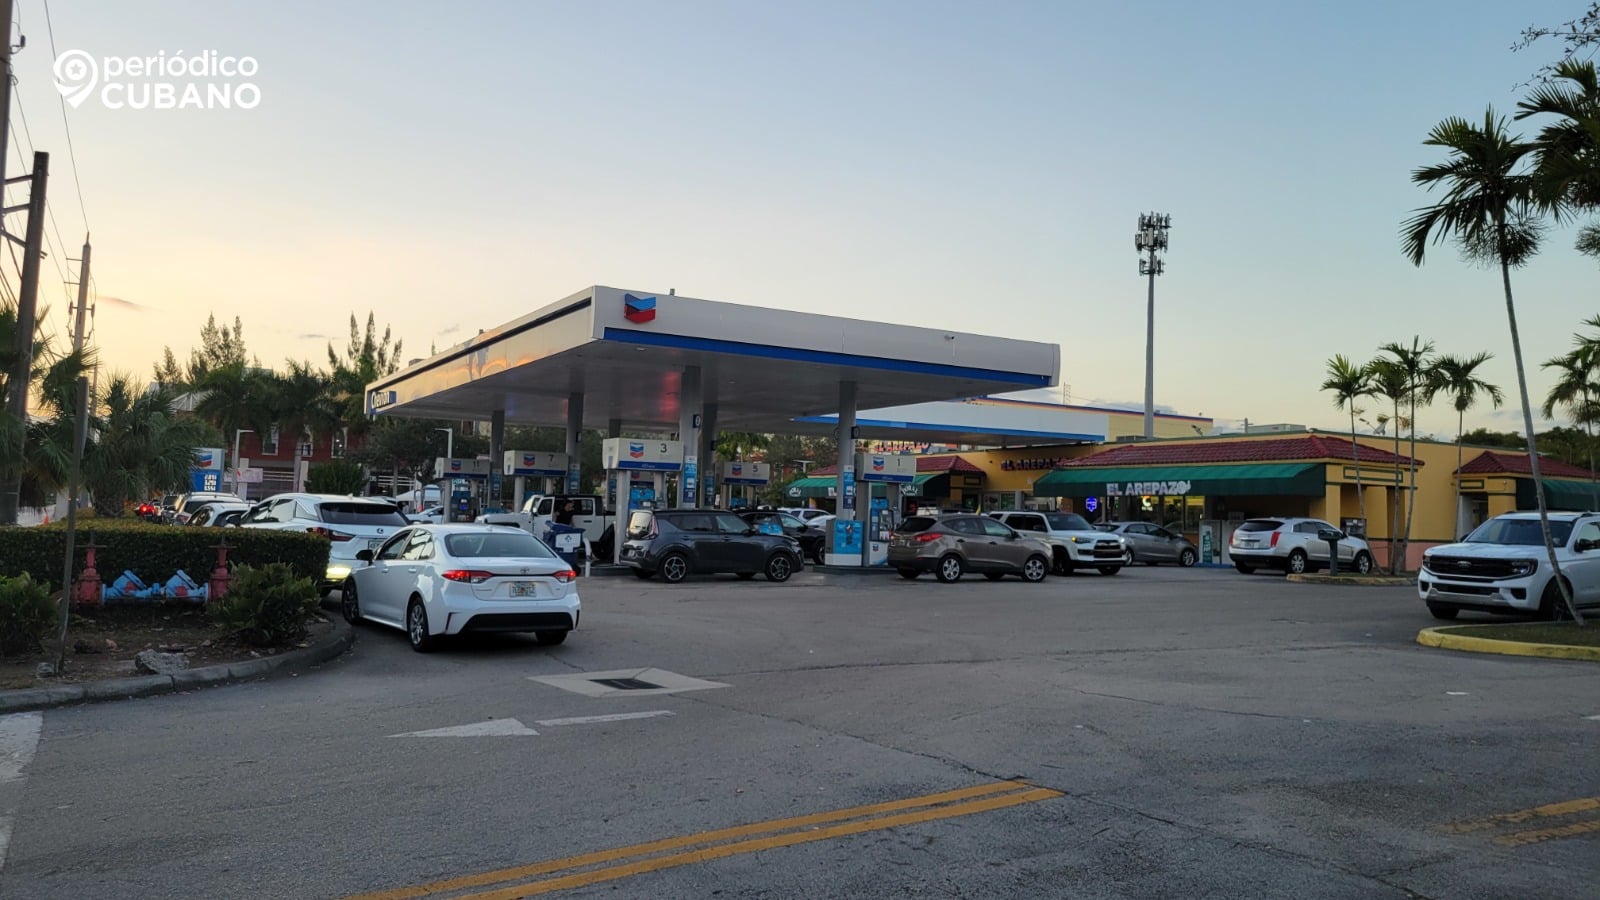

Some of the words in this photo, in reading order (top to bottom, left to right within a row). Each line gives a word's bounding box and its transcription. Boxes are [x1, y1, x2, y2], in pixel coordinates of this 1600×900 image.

[660, 443, 667, 453] 3
[549, 454, 554, 463] 7
[752, 465, 759, 473] 5
[1106, 483, 1122, 496] EL
[1125, 481, 1190, 496] AREPAZO
